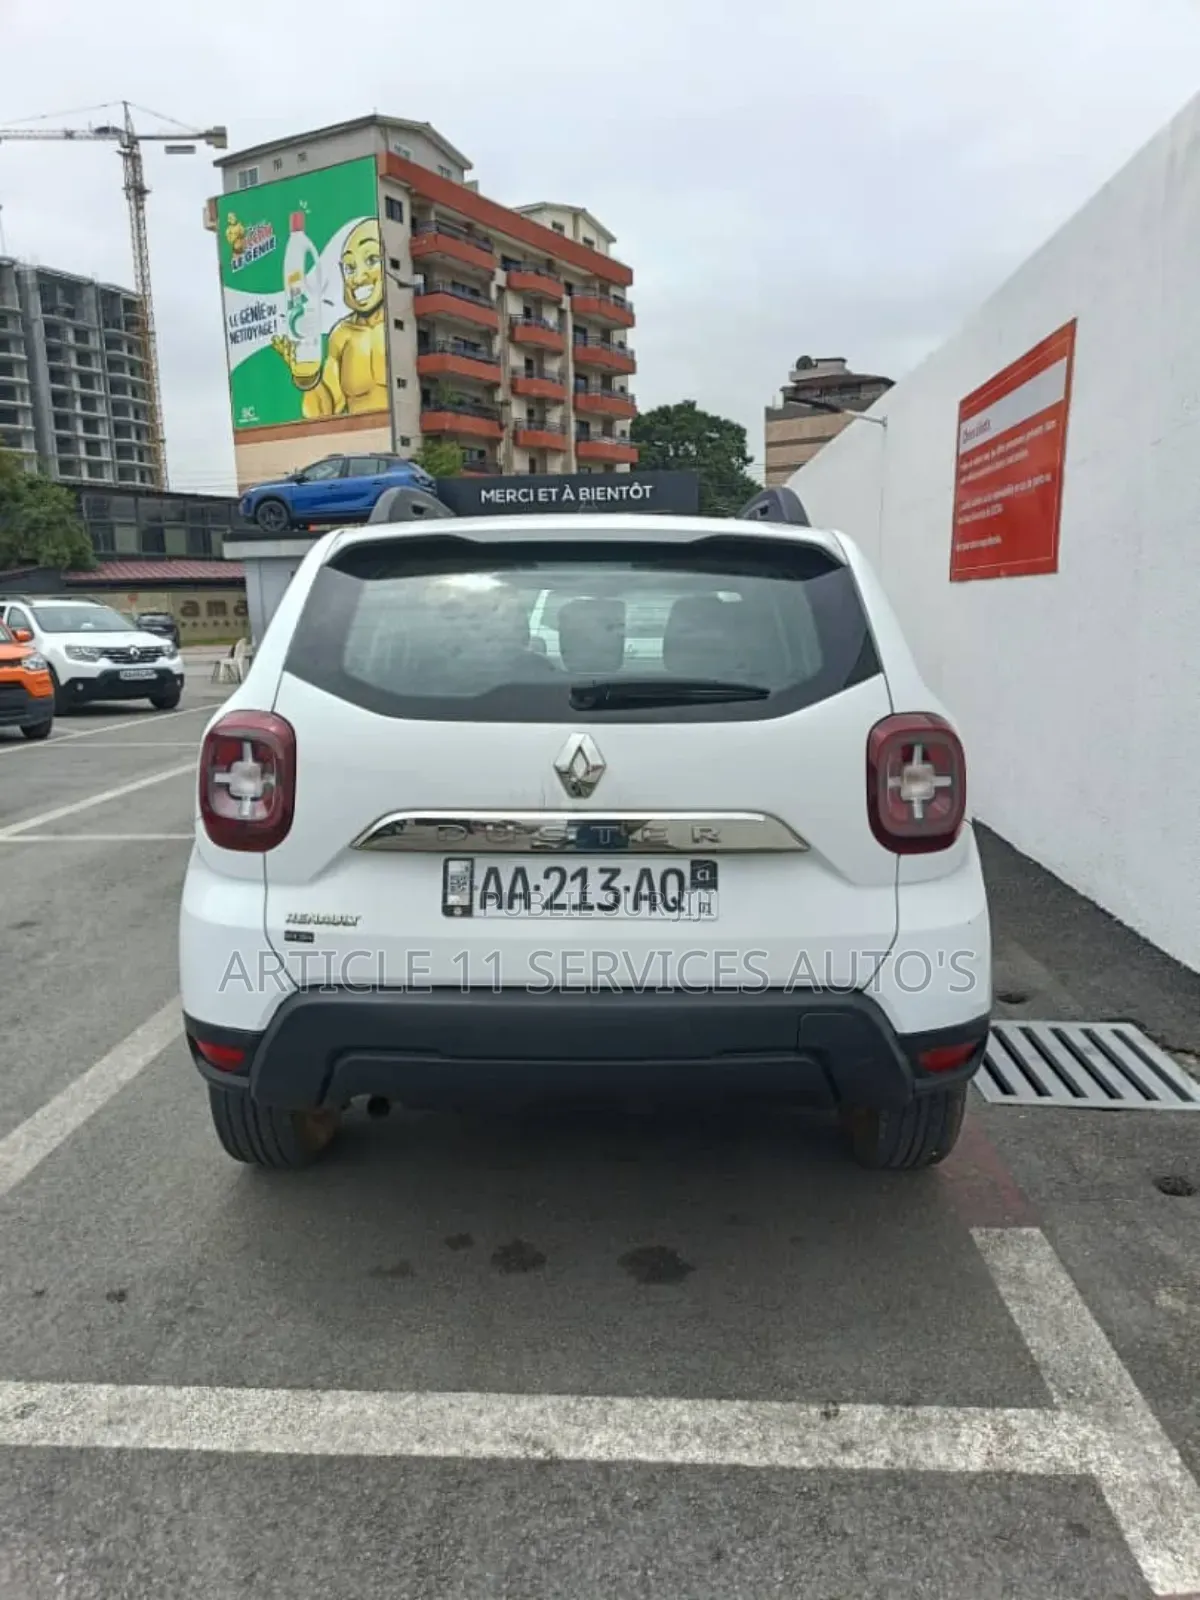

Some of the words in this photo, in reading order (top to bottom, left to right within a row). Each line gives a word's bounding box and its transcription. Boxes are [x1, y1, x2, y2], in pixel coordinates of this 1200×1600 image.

[481, 488, 534, 504] MERCI
[538, 488, 559, 502] ET
[562, 484, 575, 501] À
[579, 482, 653, 501] BIENTÔT
[436, 824, 721, 844] DUSTER
